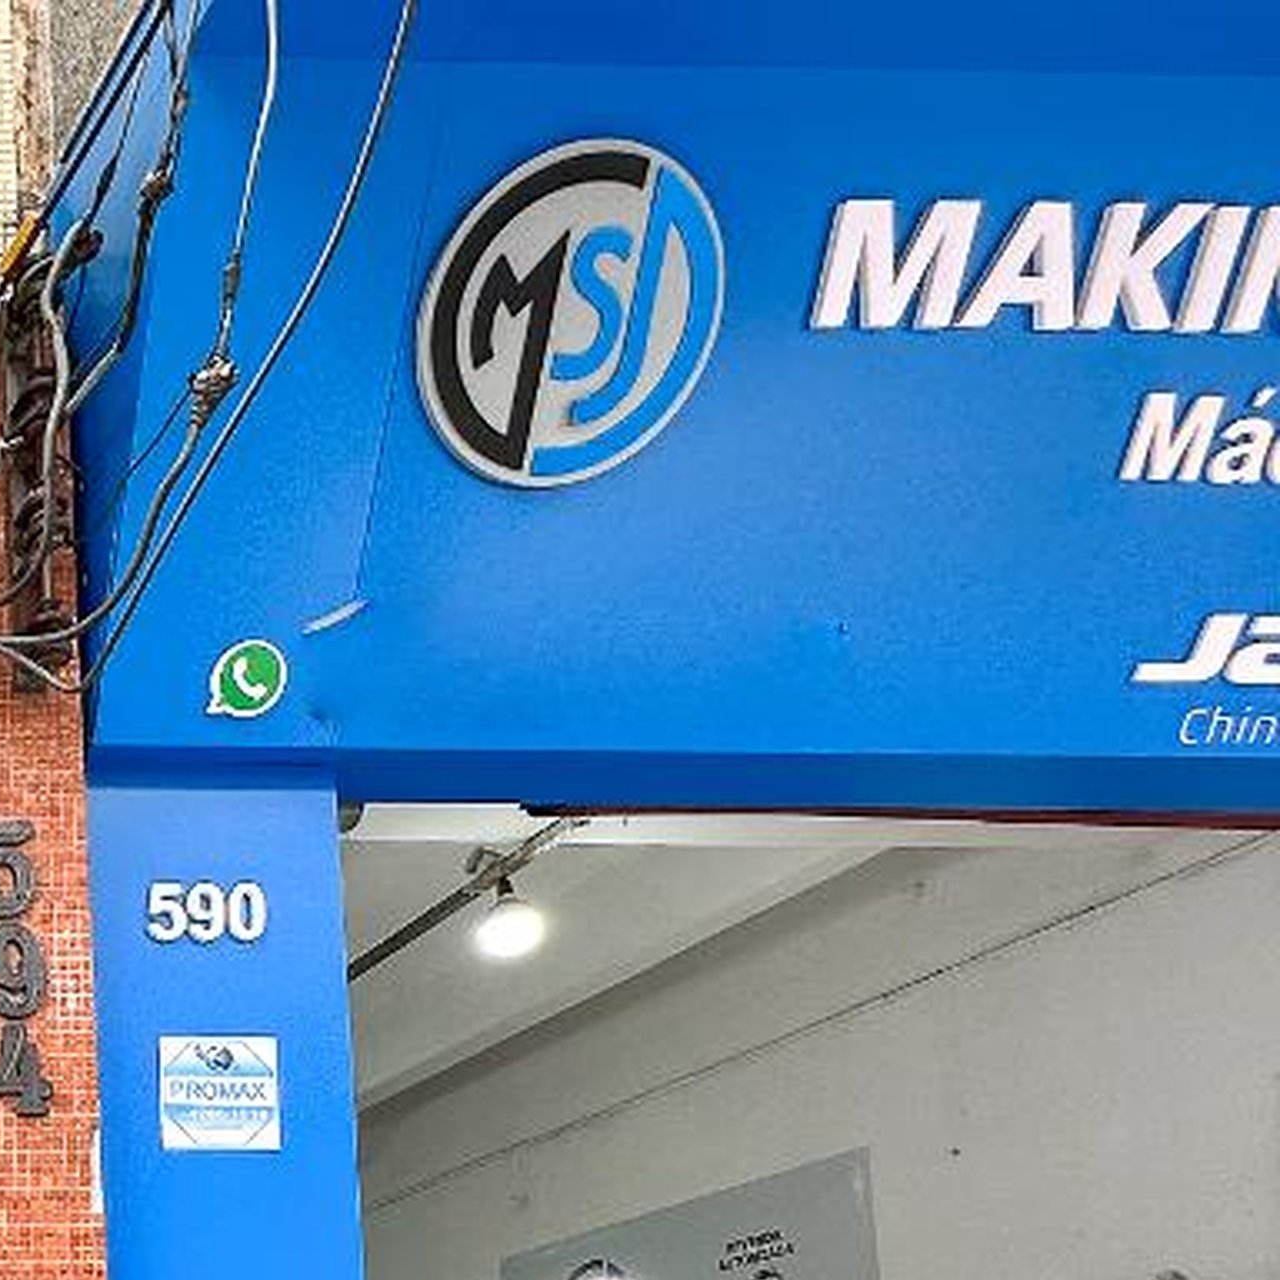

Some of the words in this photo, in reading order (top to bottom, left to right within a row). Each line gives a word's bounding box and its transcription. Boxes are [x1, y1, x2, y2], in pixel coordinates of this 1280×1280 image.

[1119, 388, 1280, 484] Má
[146, 881, 268, 944] 590
[169, 1080, 267, 1101] PROMAX
